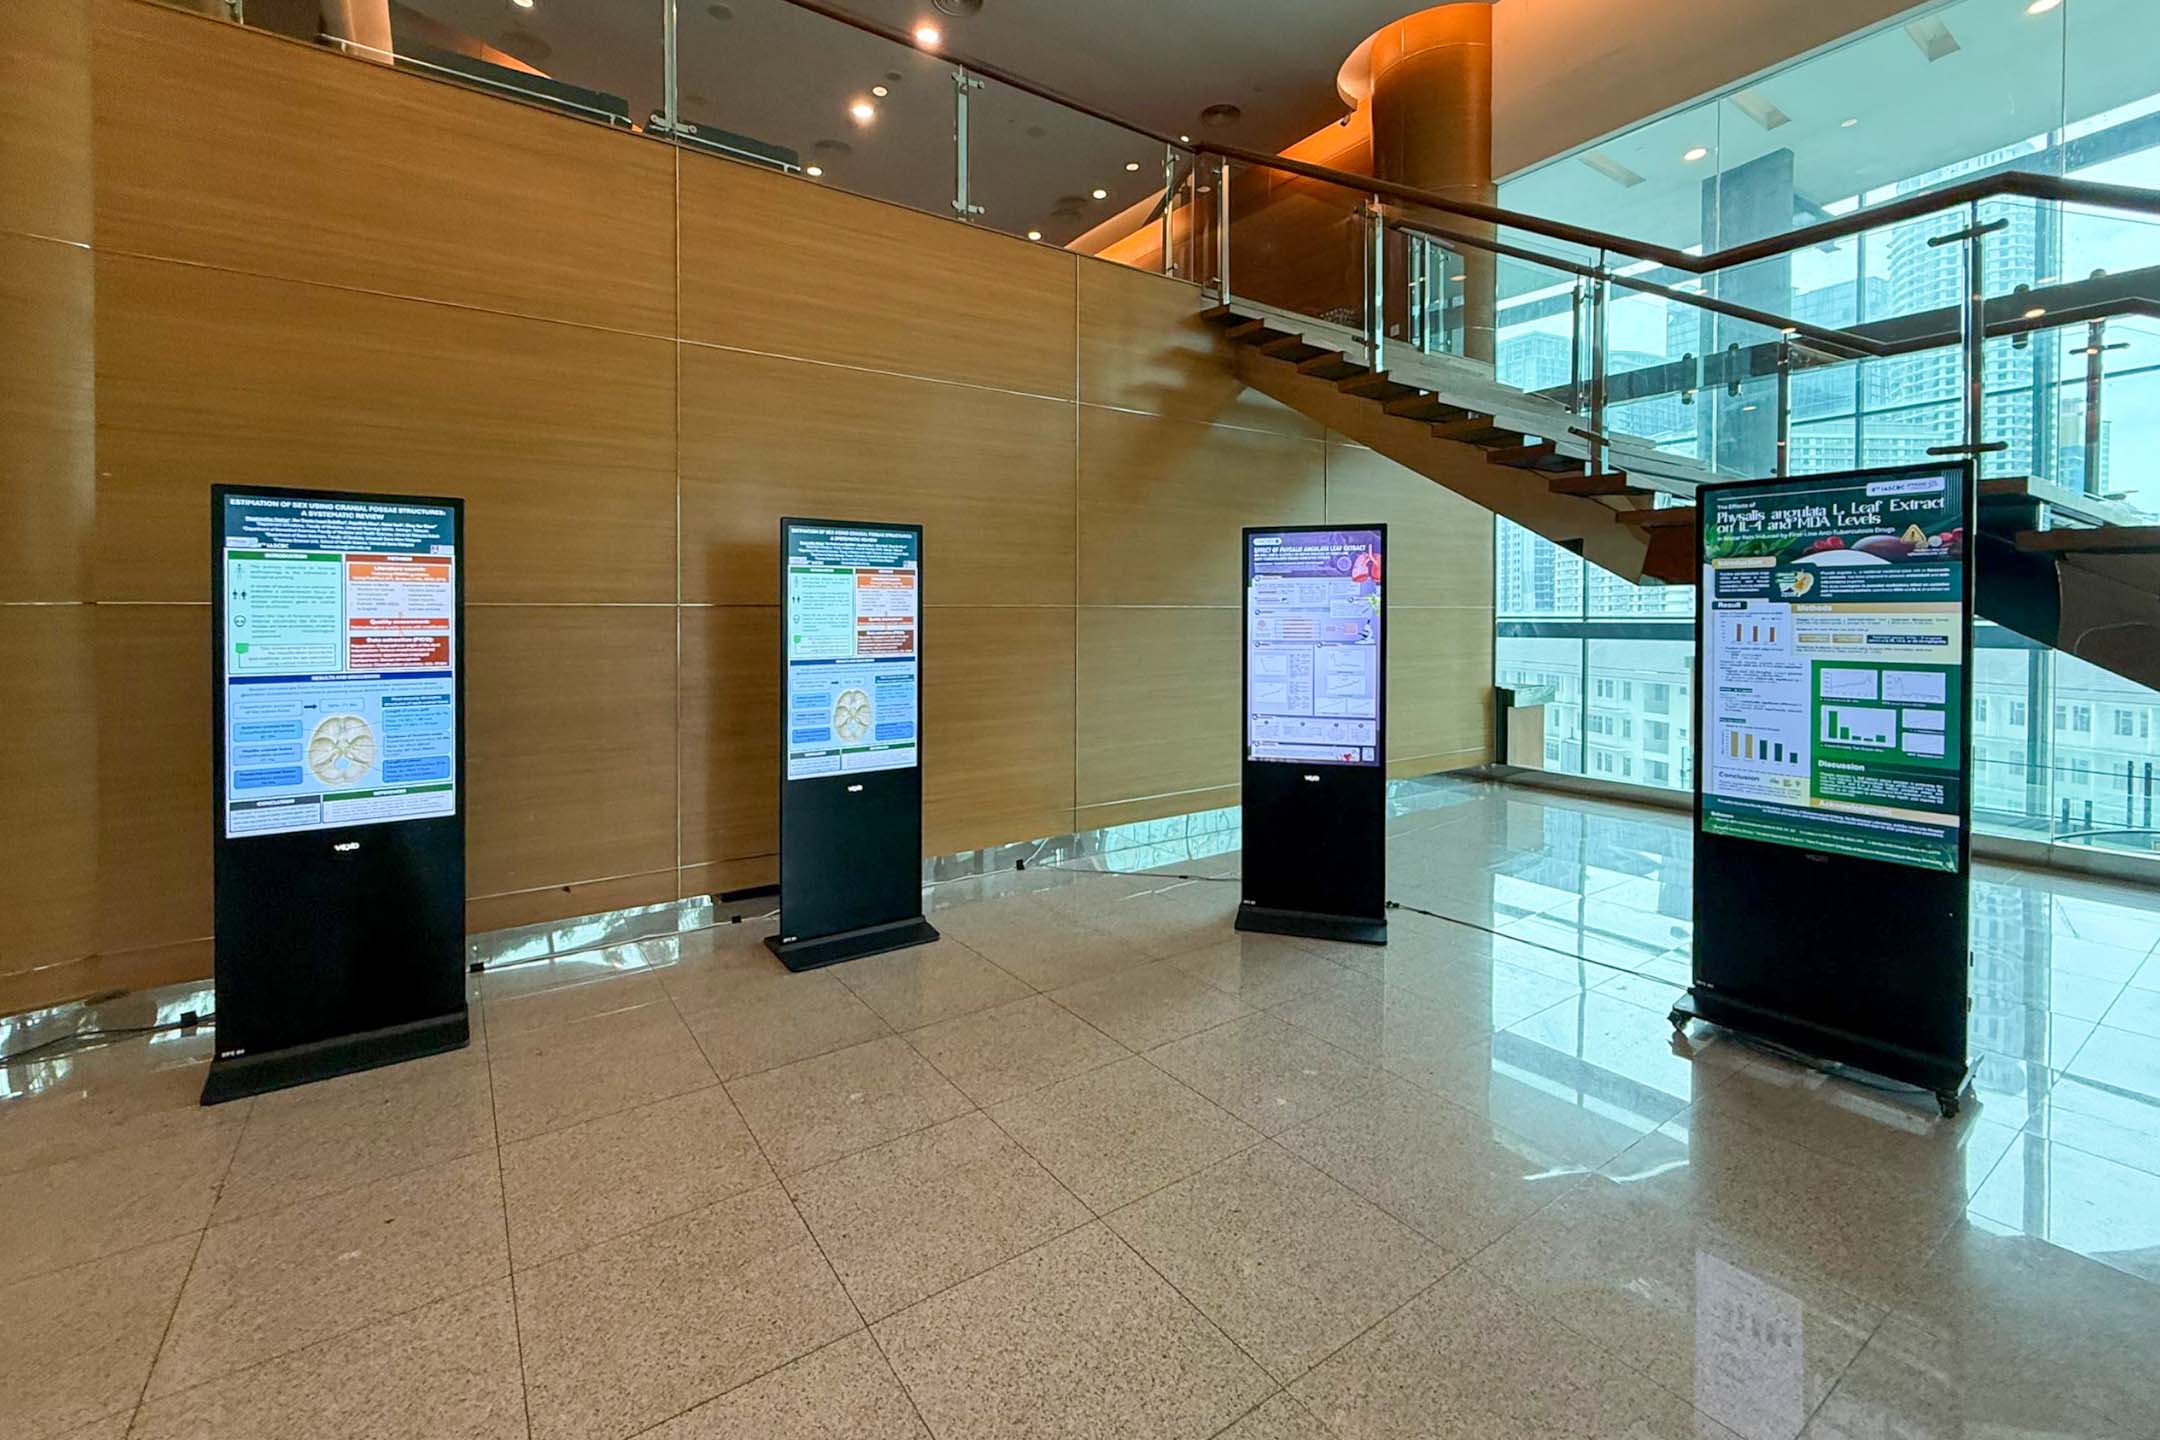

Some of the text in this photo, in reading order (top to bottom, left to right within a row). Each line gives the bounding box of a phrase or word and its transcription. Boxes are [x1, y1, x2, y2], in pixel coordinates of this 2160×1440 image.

[230, 498, 279, 507] ESTIMATION
[280, 500, 291, 508] OF
[292, 501, 308, 509] SEX
[309, 502, 334, 510] USING
[355, 512, 384, 520] REVIEW
[1717, 510, 1766, 524] Physalis
[1771, 505, 1827, 522] angulata
[1851, 500, 1883, 514] Leaf
[1890, 497, 1945, 512] Extract
[1798, 516, 1831, 528] MDA
[1838, 513, 1881, 526] Levels
[1818, 759, 1866, 772] Discussion
[1718, 771, 1761, 782] Conclusion
